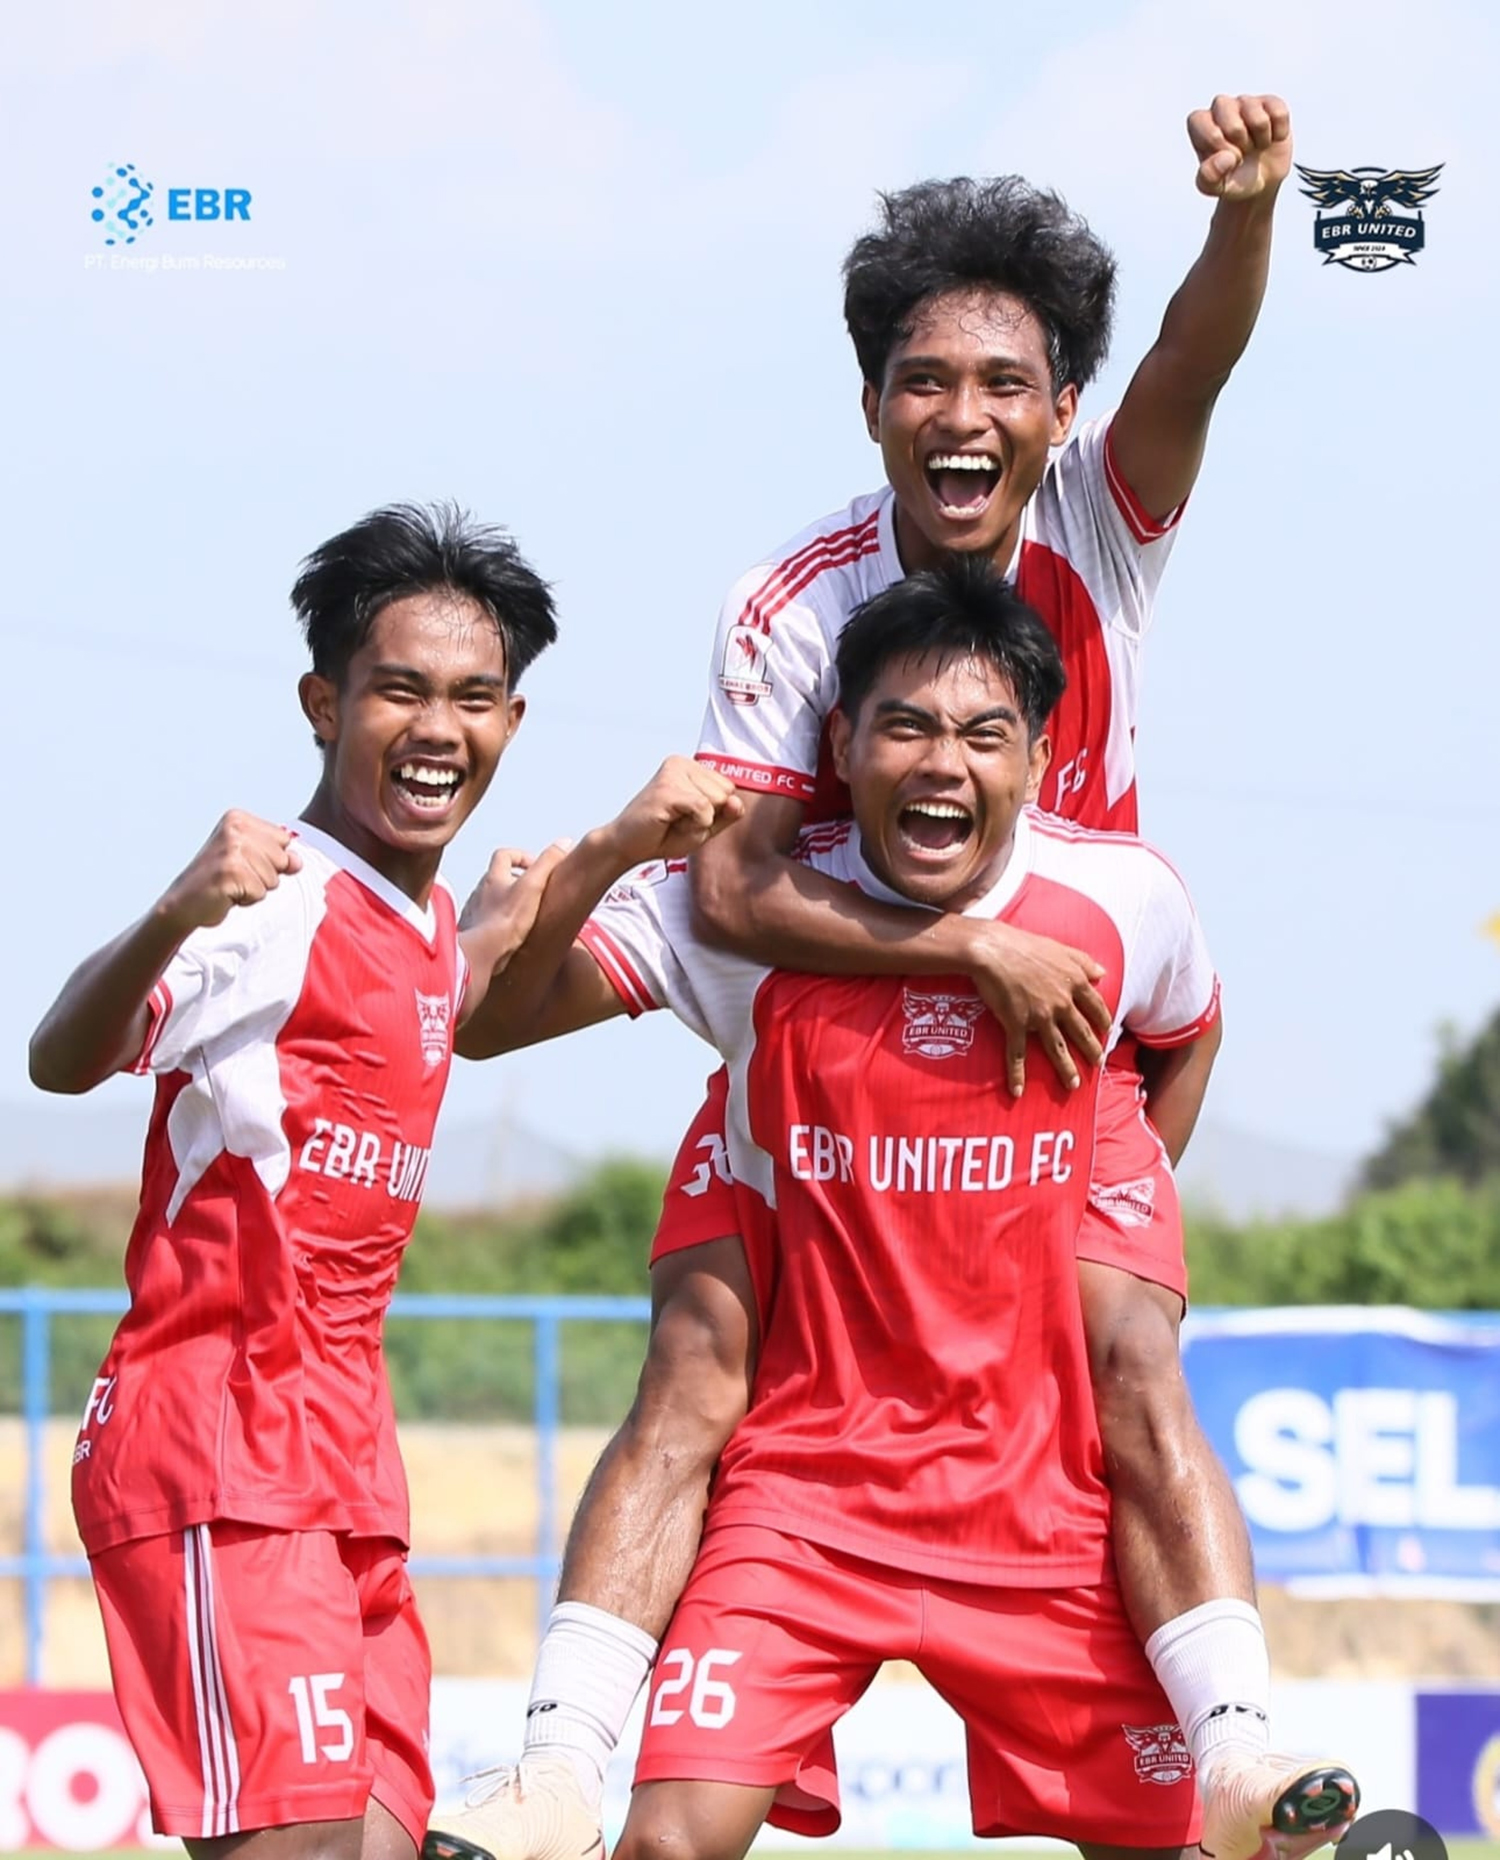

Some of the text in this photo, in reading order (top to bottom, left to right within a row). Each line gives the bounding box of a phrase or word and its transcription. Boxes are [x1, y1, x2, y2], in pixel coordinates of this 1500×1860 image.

[719, 763, 772, 784] UNITED
[777, 774, 795, 789] FC
[909, 1026, 968, 1037] EBR UNITED
[298, 1117, 381, 1189] EBR
[789, 1123, 1075, 1192] EBR UNITED FC
[288, 1672, 354, 1764] 15
[650, 1647, 744, 1730] 26
[1158, 1753, 1189, 1763] UNITED
